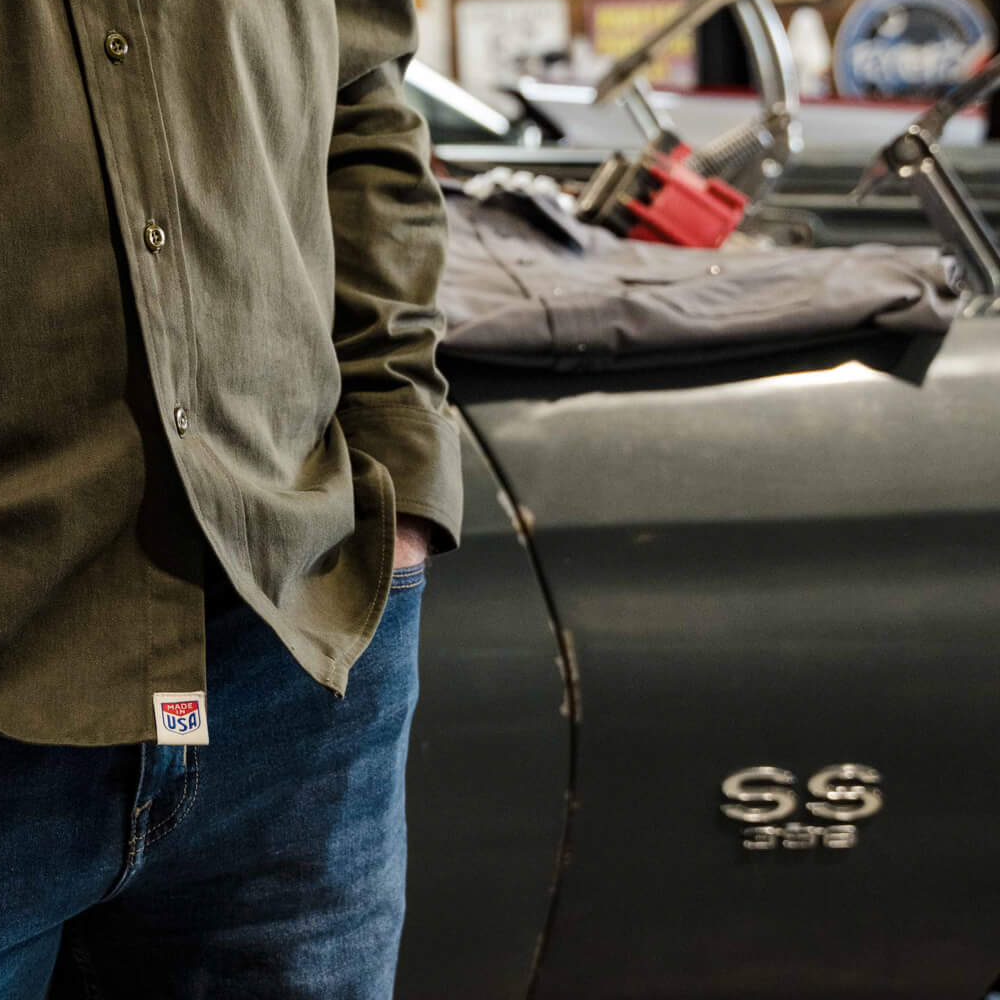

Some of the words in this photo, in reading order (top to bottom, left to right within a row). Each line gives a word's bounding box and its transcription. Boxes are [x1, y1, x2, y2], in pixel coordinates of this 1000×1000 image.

[167, 702, 193, 711] MADE
[167, 712, 197, 732] USA
[720, 763, 884, 823] SS
